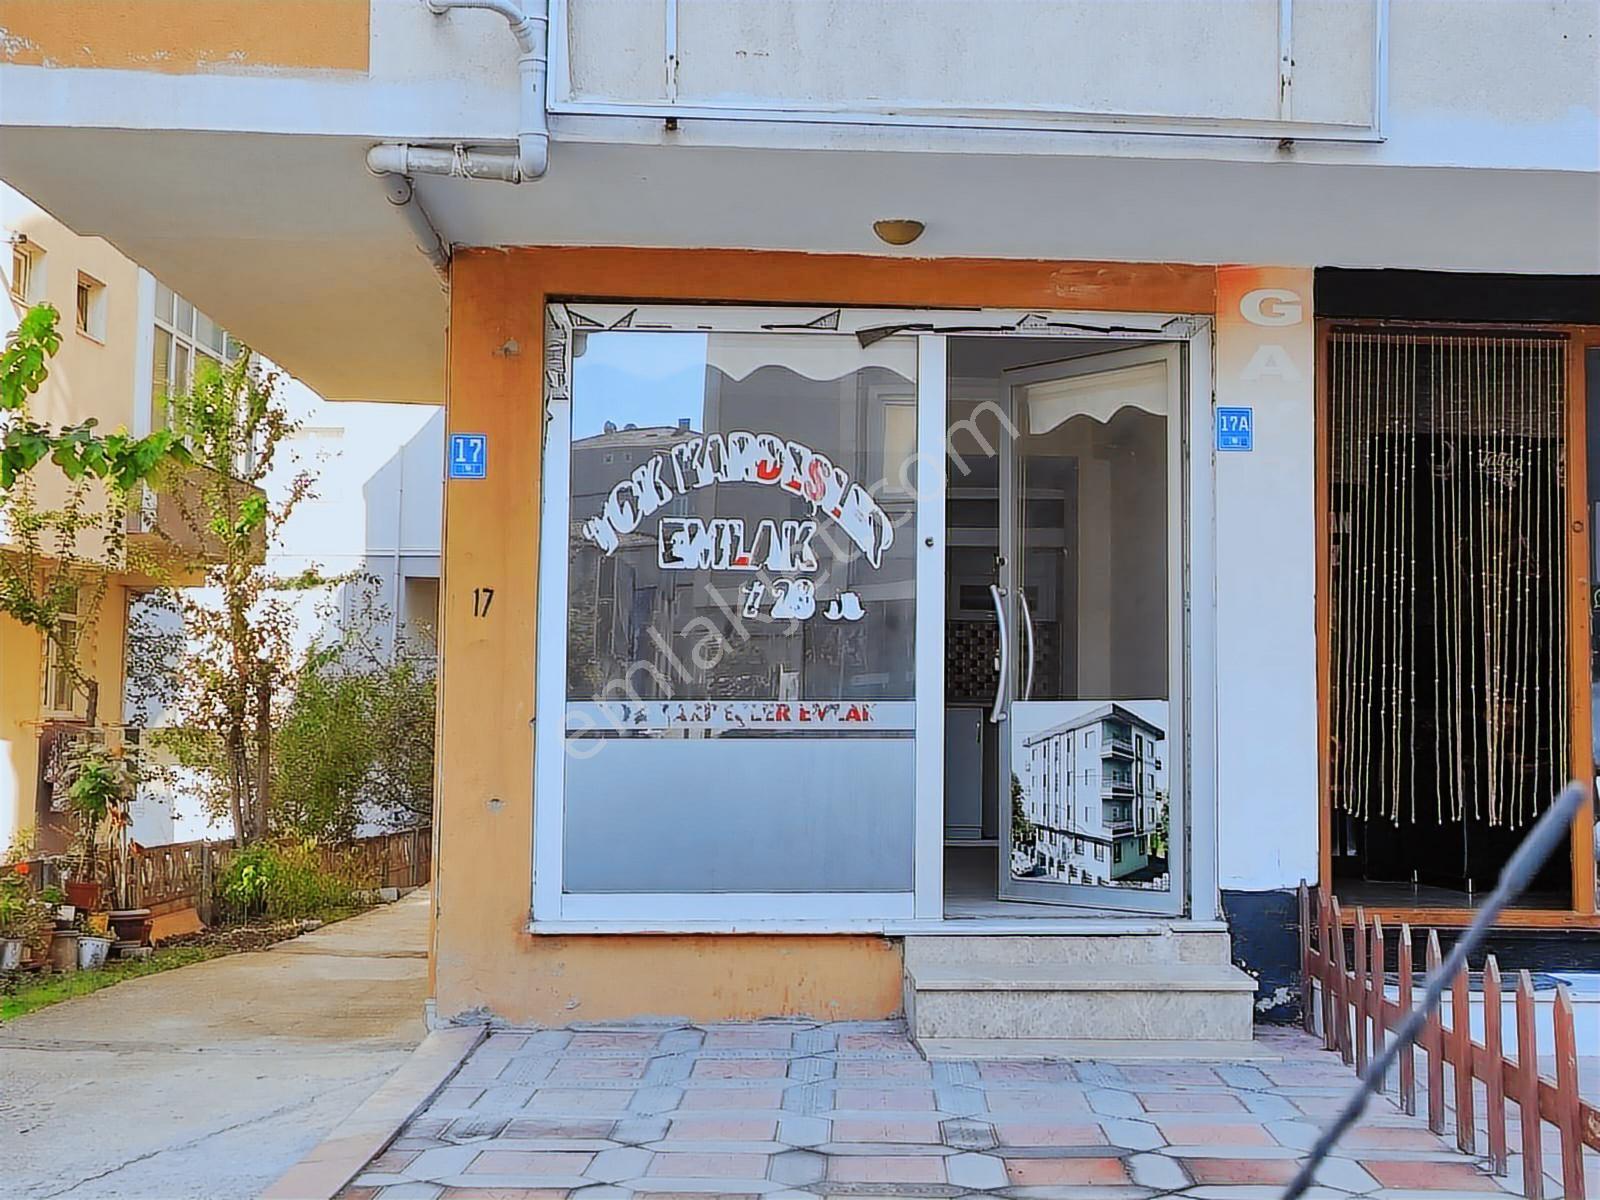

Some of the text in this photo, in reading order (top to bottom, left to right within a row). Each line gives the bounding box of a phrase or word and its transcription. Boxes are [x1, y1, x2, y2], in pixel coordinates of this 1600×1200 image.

[1221, 415, 1249, 431] 17A
[455, 438, 482, 462] 17
[472, 588, 495, 617] 17
